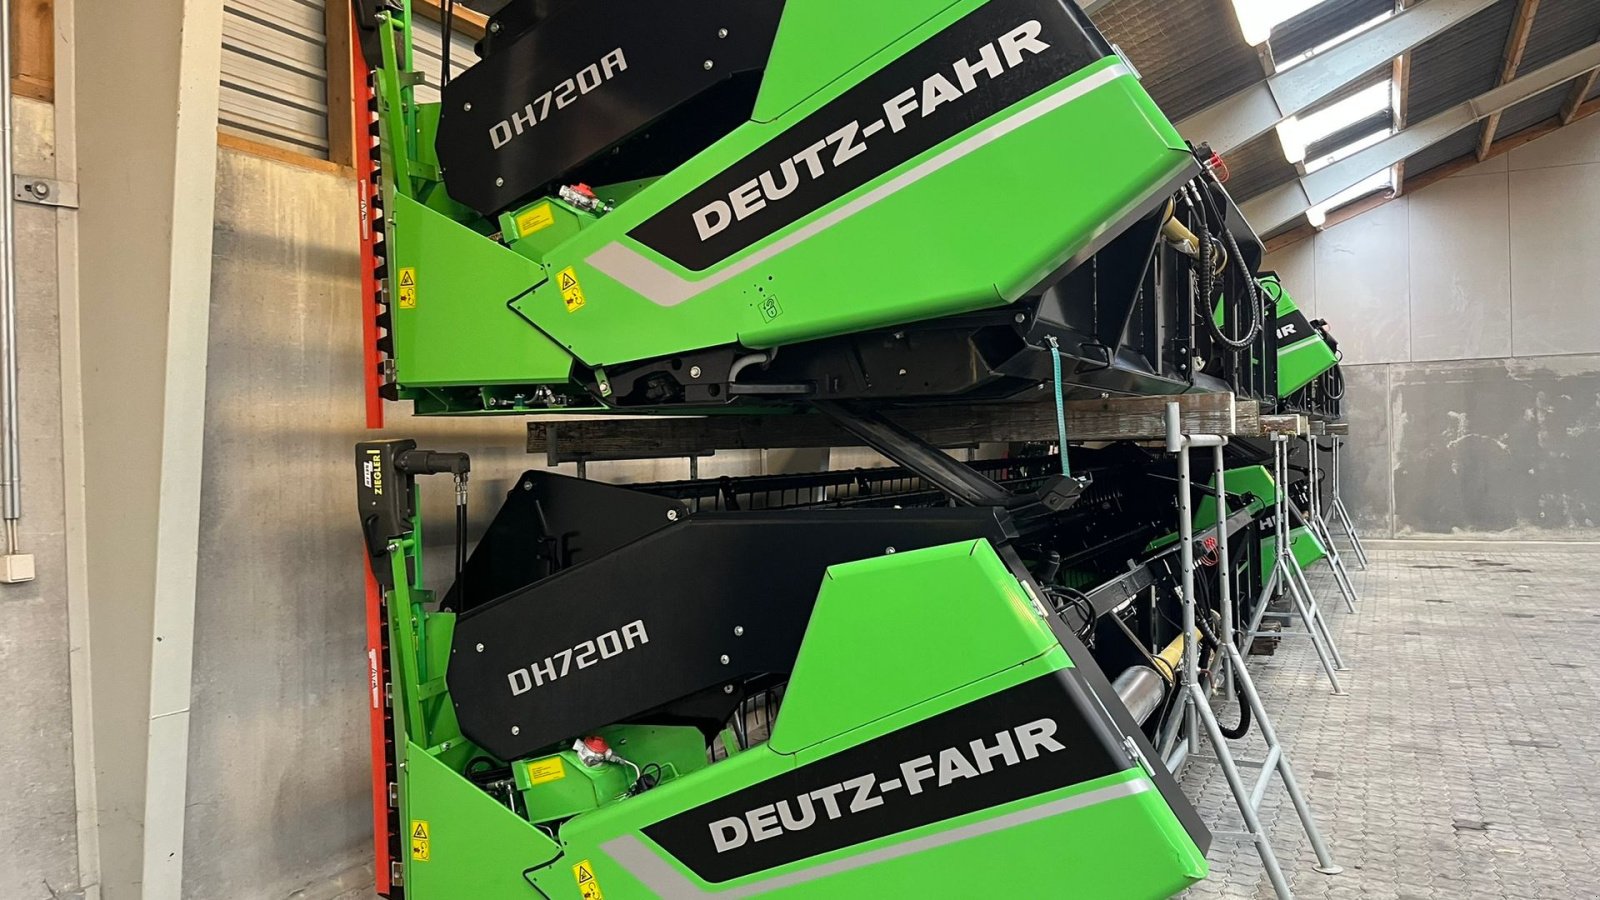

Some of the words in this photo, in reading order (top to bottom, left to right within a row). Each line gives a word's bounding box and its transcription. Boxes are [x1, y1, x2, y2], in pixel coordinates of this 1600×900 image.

[489, 48, 627, 149] DH720A
[693, 20, 1050, 241] DEUTZ-FAHR
[372, 455, 382, 495] ZIEGLER
[508, 620, 649, 696] DH720A
[709, 719, 1065, 852] DEUTZ-FAHR
